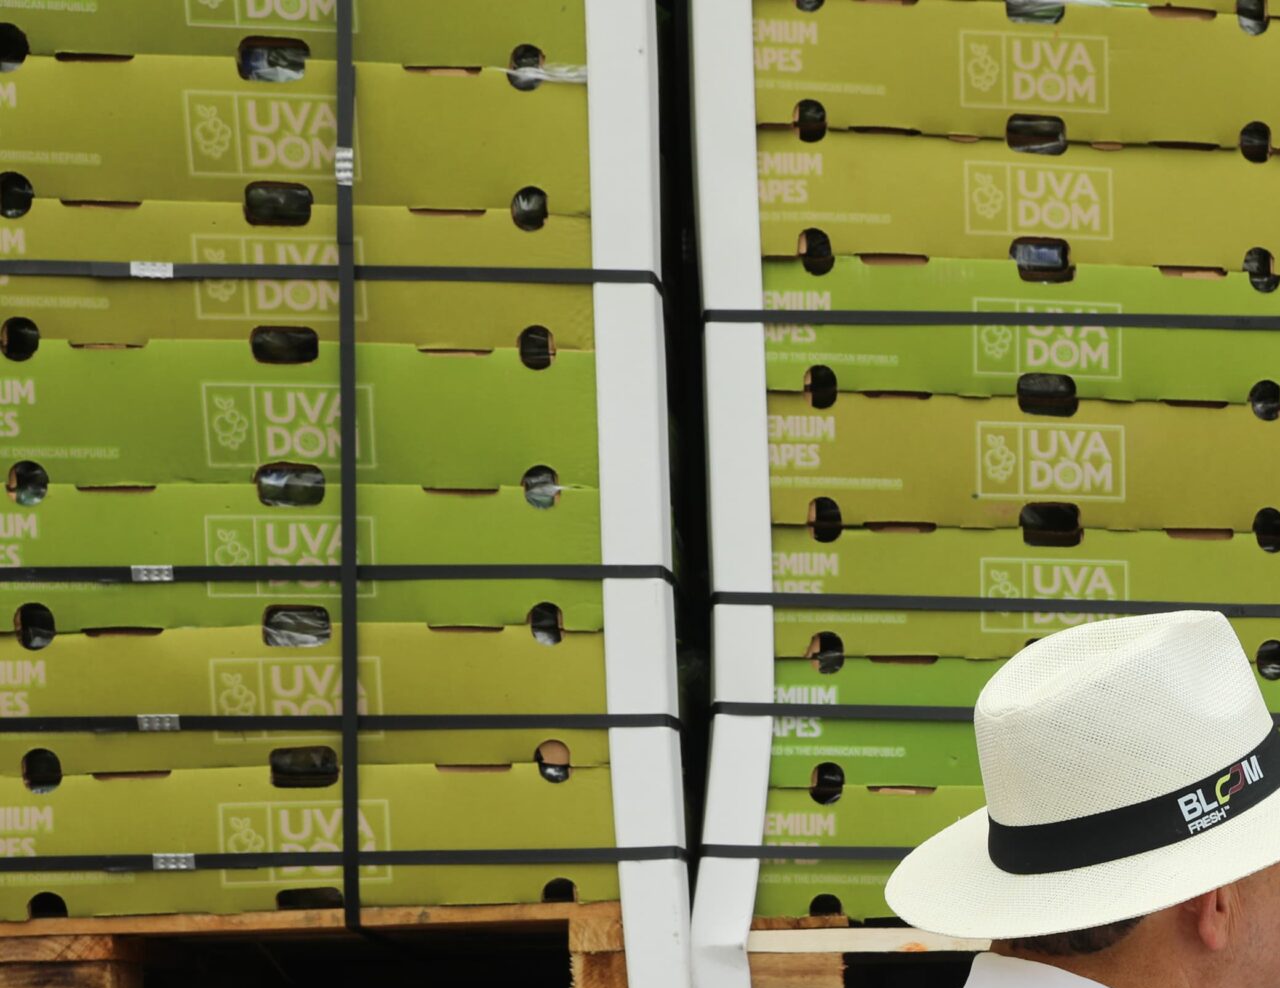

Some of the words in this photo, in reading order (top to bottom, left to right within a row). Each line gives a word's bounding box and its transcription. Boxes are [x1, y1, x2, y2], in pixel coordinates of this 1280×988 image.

[753, 19, 818, 45] EMIUM
[754, 46, 803, 73] APES
[1012, 40, 1096, 73] UVA
[1013, 71, 1096, 104] DOM
[247, 100, 337, 135] UVA
[757, 151, 823, 176] EMIUM
[758, 179, 809, 203] APES
[1016, 169, 1099, 201] UVA
[1017, 199, 1101, 231] DOM
[763, 290, 831, 311] EMIUM
[764, 323, 817, 343] APES
[1026, 337, 1109, 369] DOM
[767, 415, 836, 441] EMIUM
[768, 443, 821, 468] APES
[1029, 429, 1112, 460] UVA
[1030, 458, 1114, 492] DOM
[772, 552, 839, 577] EMIUM
[1033, 565, 1115, 595] UVA
[773, 716, 822, 738] APES
[765, 812, 836, 837] EMIUM
